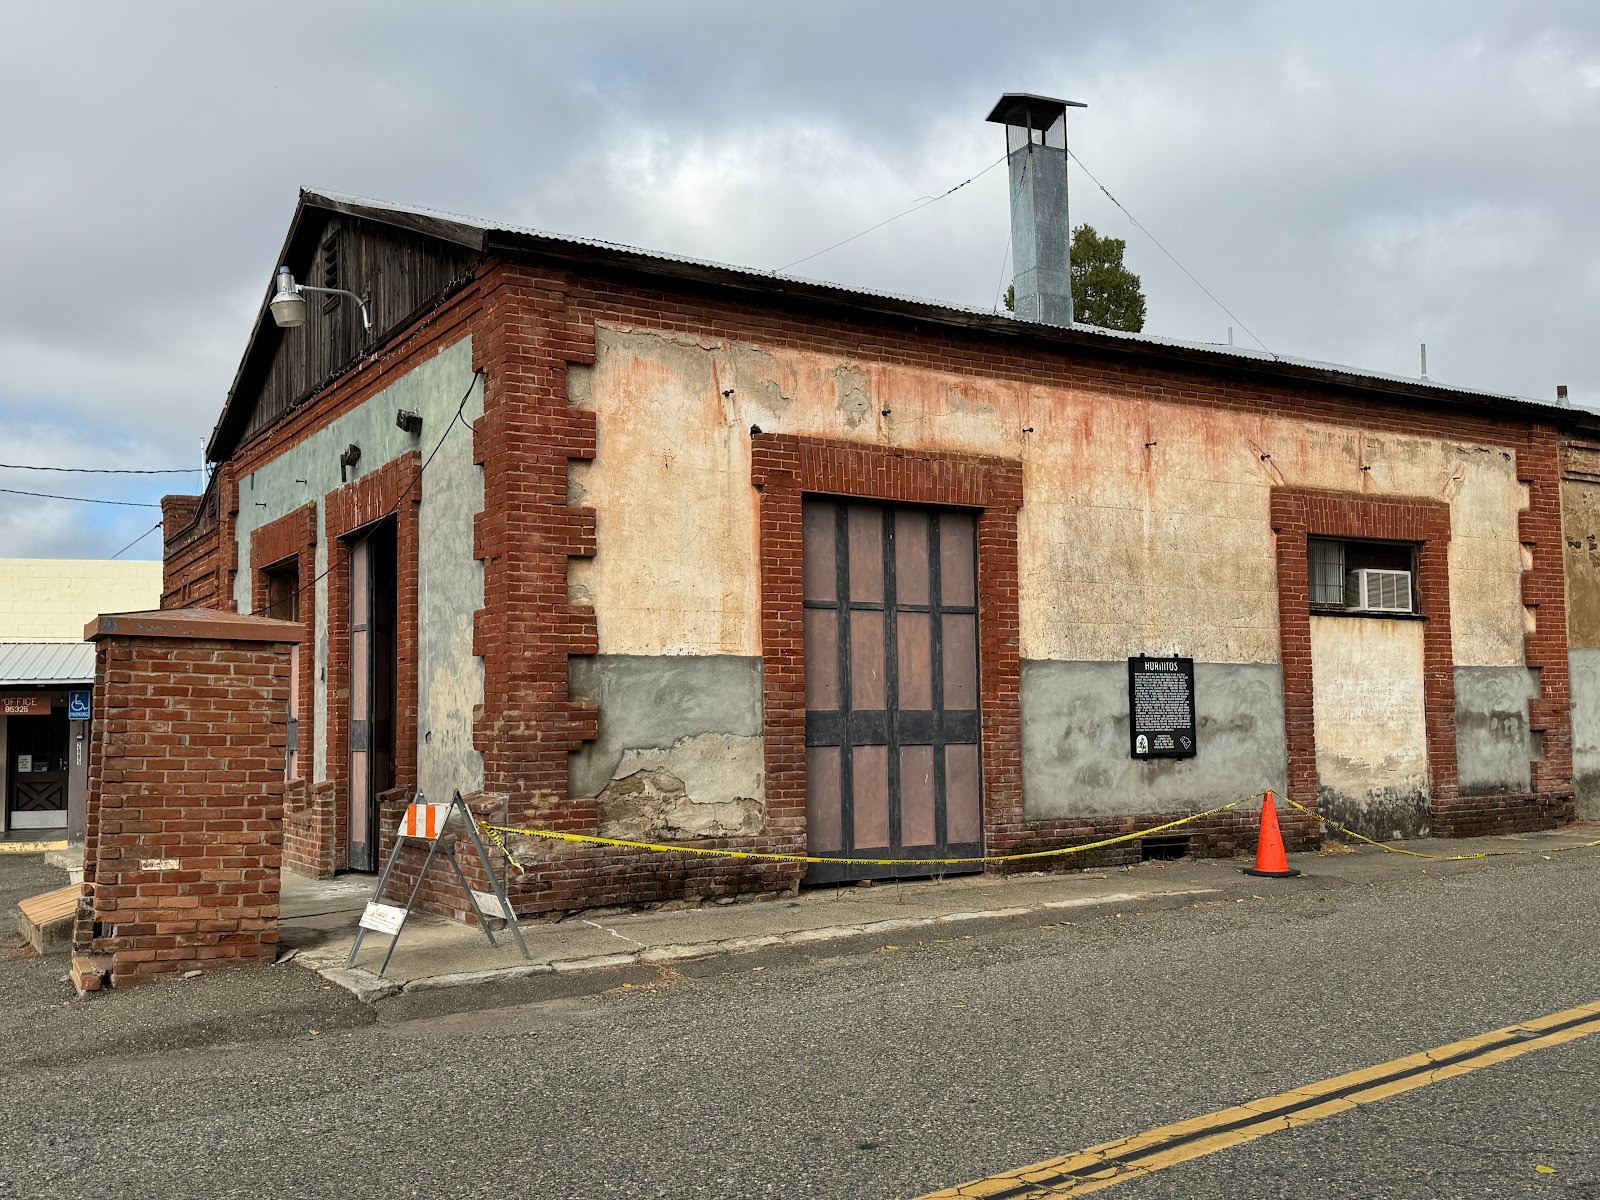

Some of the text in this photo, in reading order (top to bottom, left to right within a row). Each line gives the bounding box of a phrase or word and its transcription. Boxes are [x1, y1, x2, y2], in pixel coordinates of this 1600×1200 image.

[1144, 661, 1178, 671] HORNITOS
[4, 697, 38, 706] OFFICE
[5, 705, 29, 713] 95325
